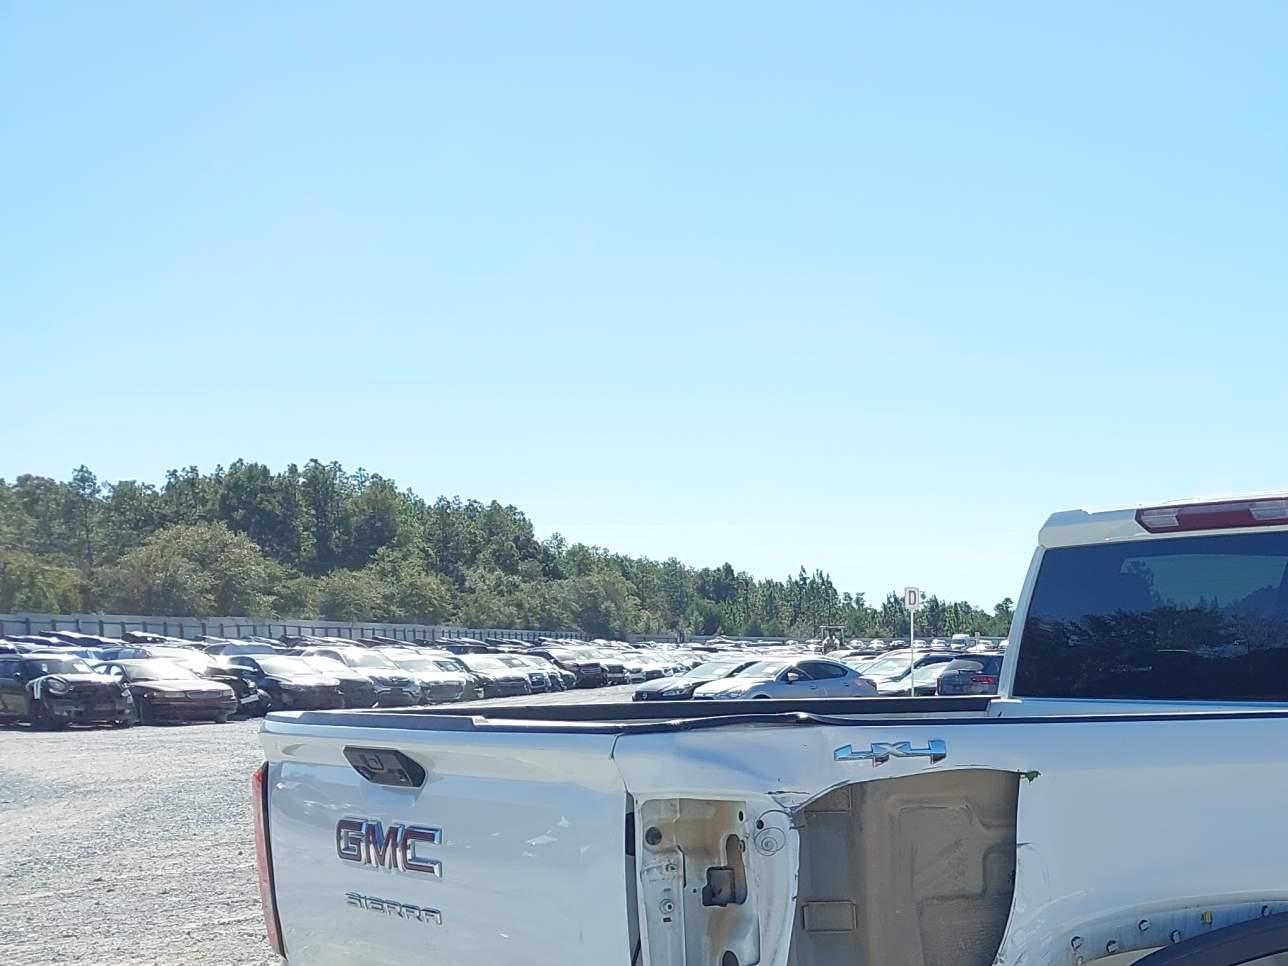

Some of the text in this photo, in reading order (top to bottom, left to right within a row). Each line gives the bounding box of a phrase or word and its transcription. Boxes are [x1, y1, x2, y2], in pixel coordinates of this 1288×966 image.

[908, 590, 917, 605] D
[336, 814, 443, 878] GMC
[344, 891, 443, 925] SIERRA
